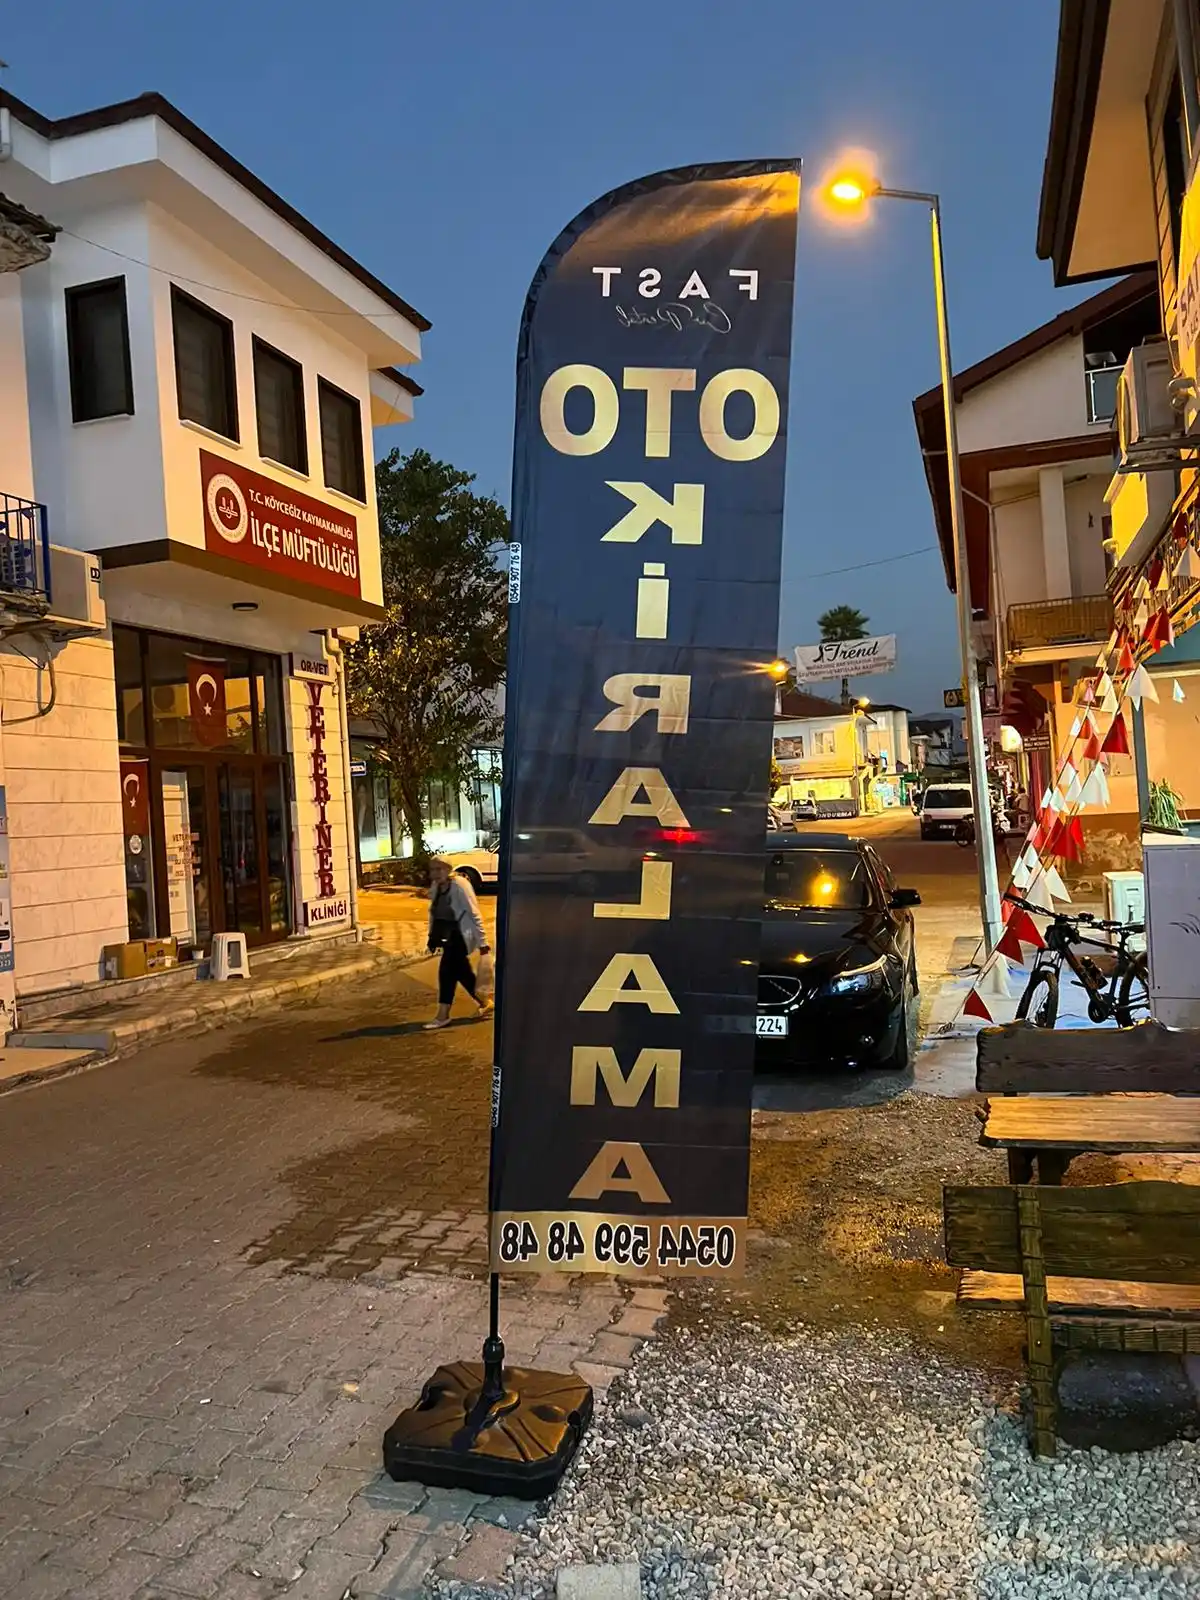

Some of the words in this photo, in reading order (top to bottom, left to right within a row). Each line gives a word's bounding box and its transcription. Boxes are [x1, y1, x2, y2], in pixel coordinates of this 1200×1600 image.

[249, 489, 264, 506] T.C.
[264, 495, 302, 520] KÖYCEĞİZ
[302, 510, 354, 540] KAYMAKAMLIĞI
[250, 510, 281, 558] İLÇE
[282, 527, 357, 579] MÜFTÜLÜĞÜ
[825, 641, 879, 661] Trend
[307, 681, 336, 898] VETERİNER
[311, 900, 347, 921] KLİNİĞİ
